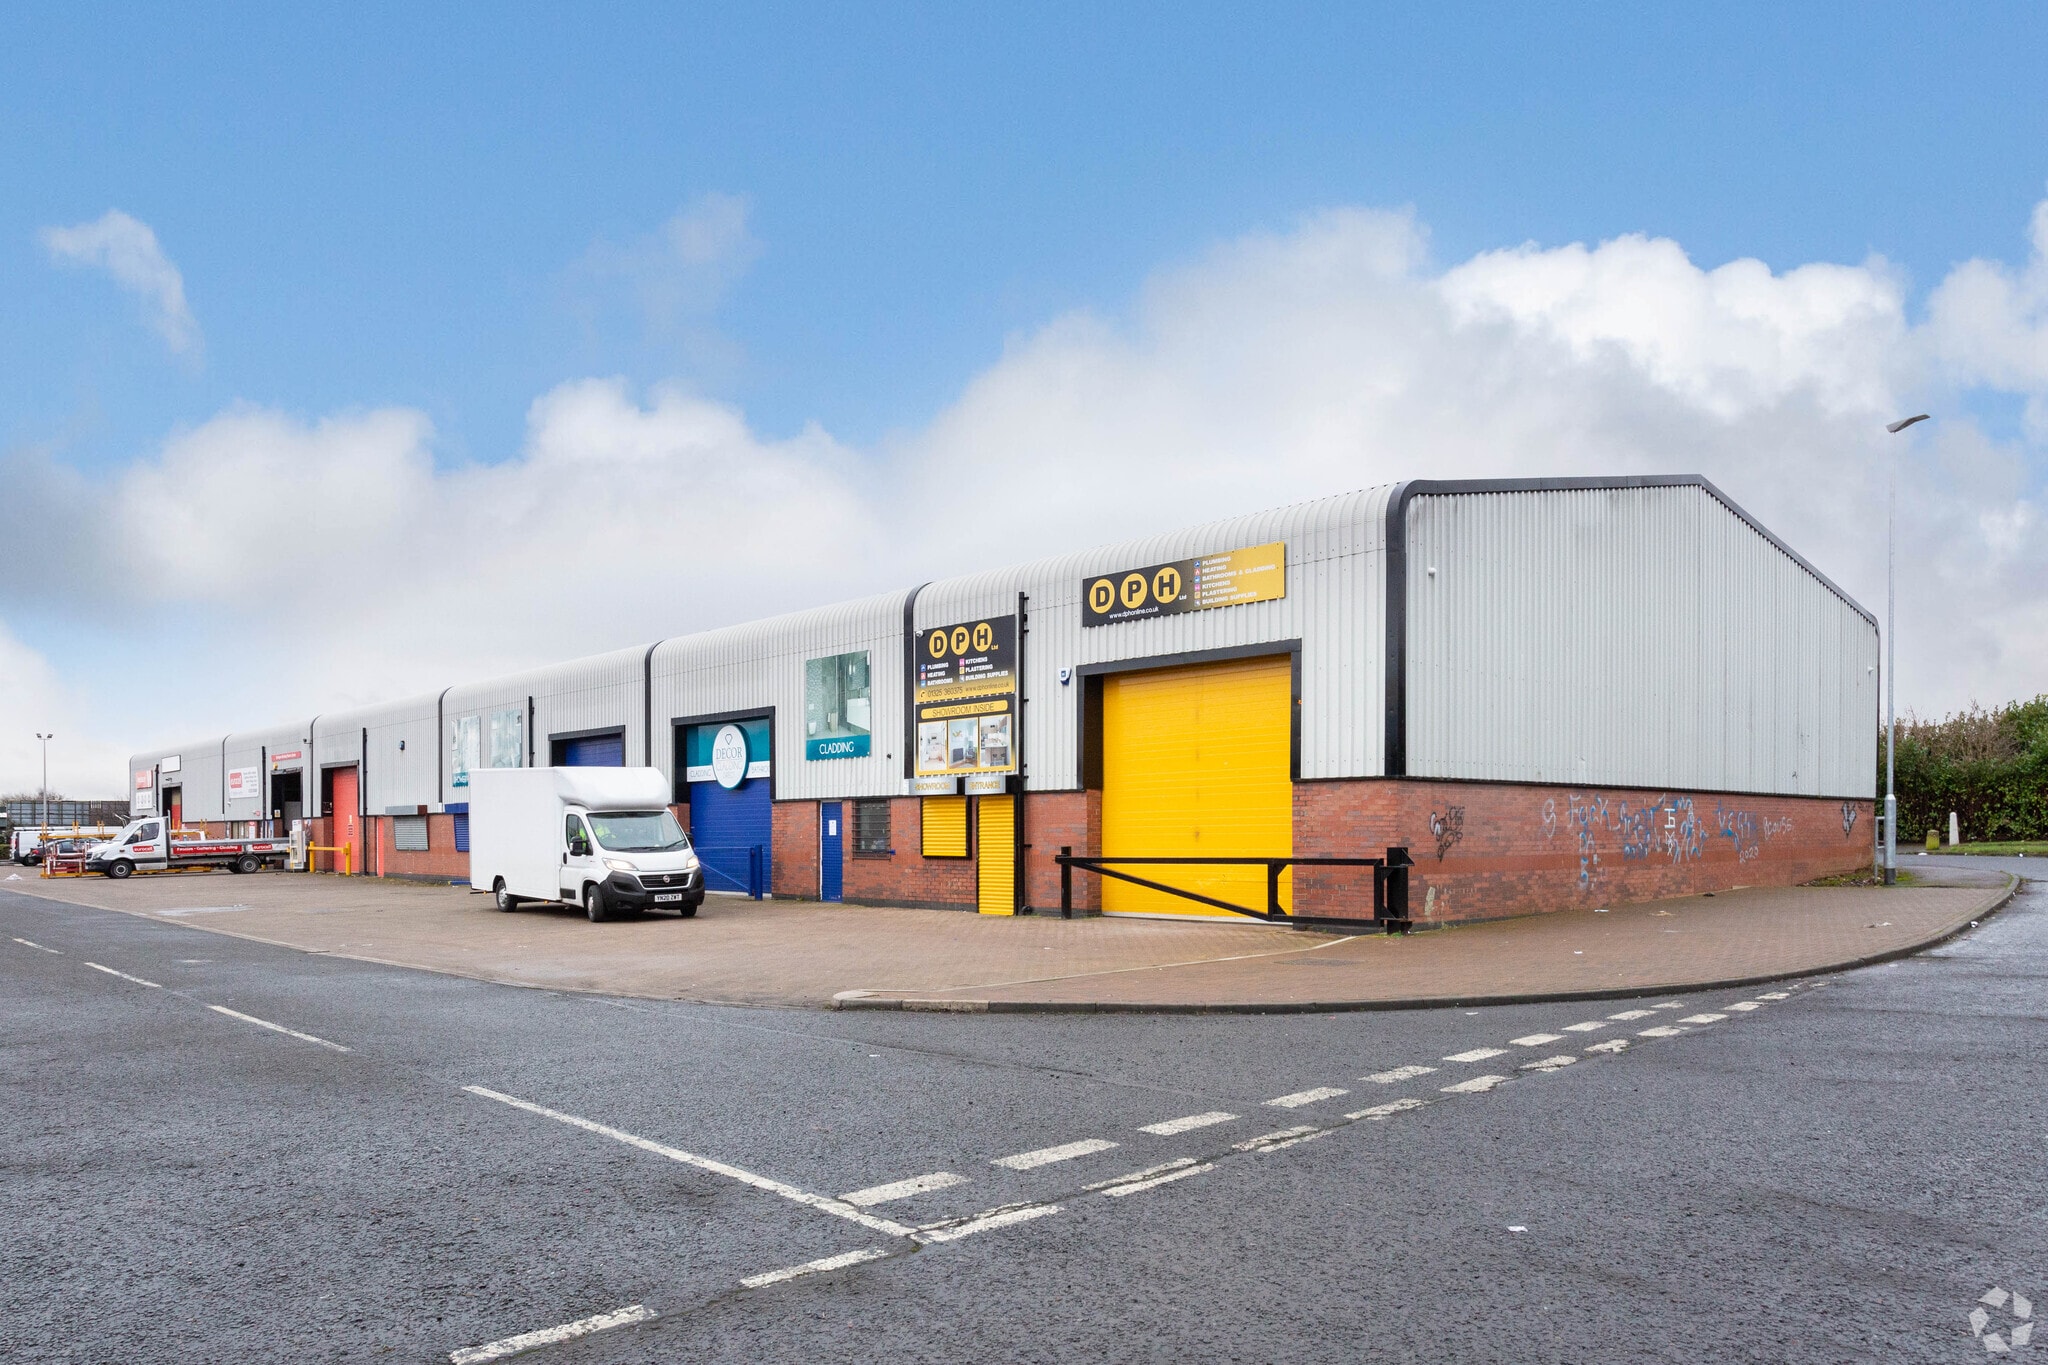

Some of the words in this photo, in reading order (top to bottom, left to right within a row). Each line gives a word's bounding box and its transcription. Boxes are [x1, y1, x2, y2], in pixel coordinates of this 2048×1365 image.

[1202, 556, 1231, 566] PLUMBING
[1202, 565, 1227, 574] HEATING
[1202, 570, 1237, 581] BATHROOMS
[1245, 564, 1276, 574] CLADDING
[1202, 580, 1230, 589] KITCHENS
[1202, 586, 1237, 597] PLASTERING
[1202, 595, 1228, 605] BUILDING
[1230, 591, 1257, 601] SUPPLIES
[965, 656, 988, 665] KITCHENS
[927, 662, 949, 670] PLUMBING
[965, 664, 993, 673] PLASTERING
[965, 673, 986, 681] BUILDING
[987, 670, 1009, 679] SUPPLIES
[927, 677, 953, 686] BATHROOMS
[932, 705, 971, 717] SHOWROOM
[974, 703, 995, 712] INSIDE
[819, 741, 854, 754] CLADDING
[716, 747, 742, 759] DECOR
